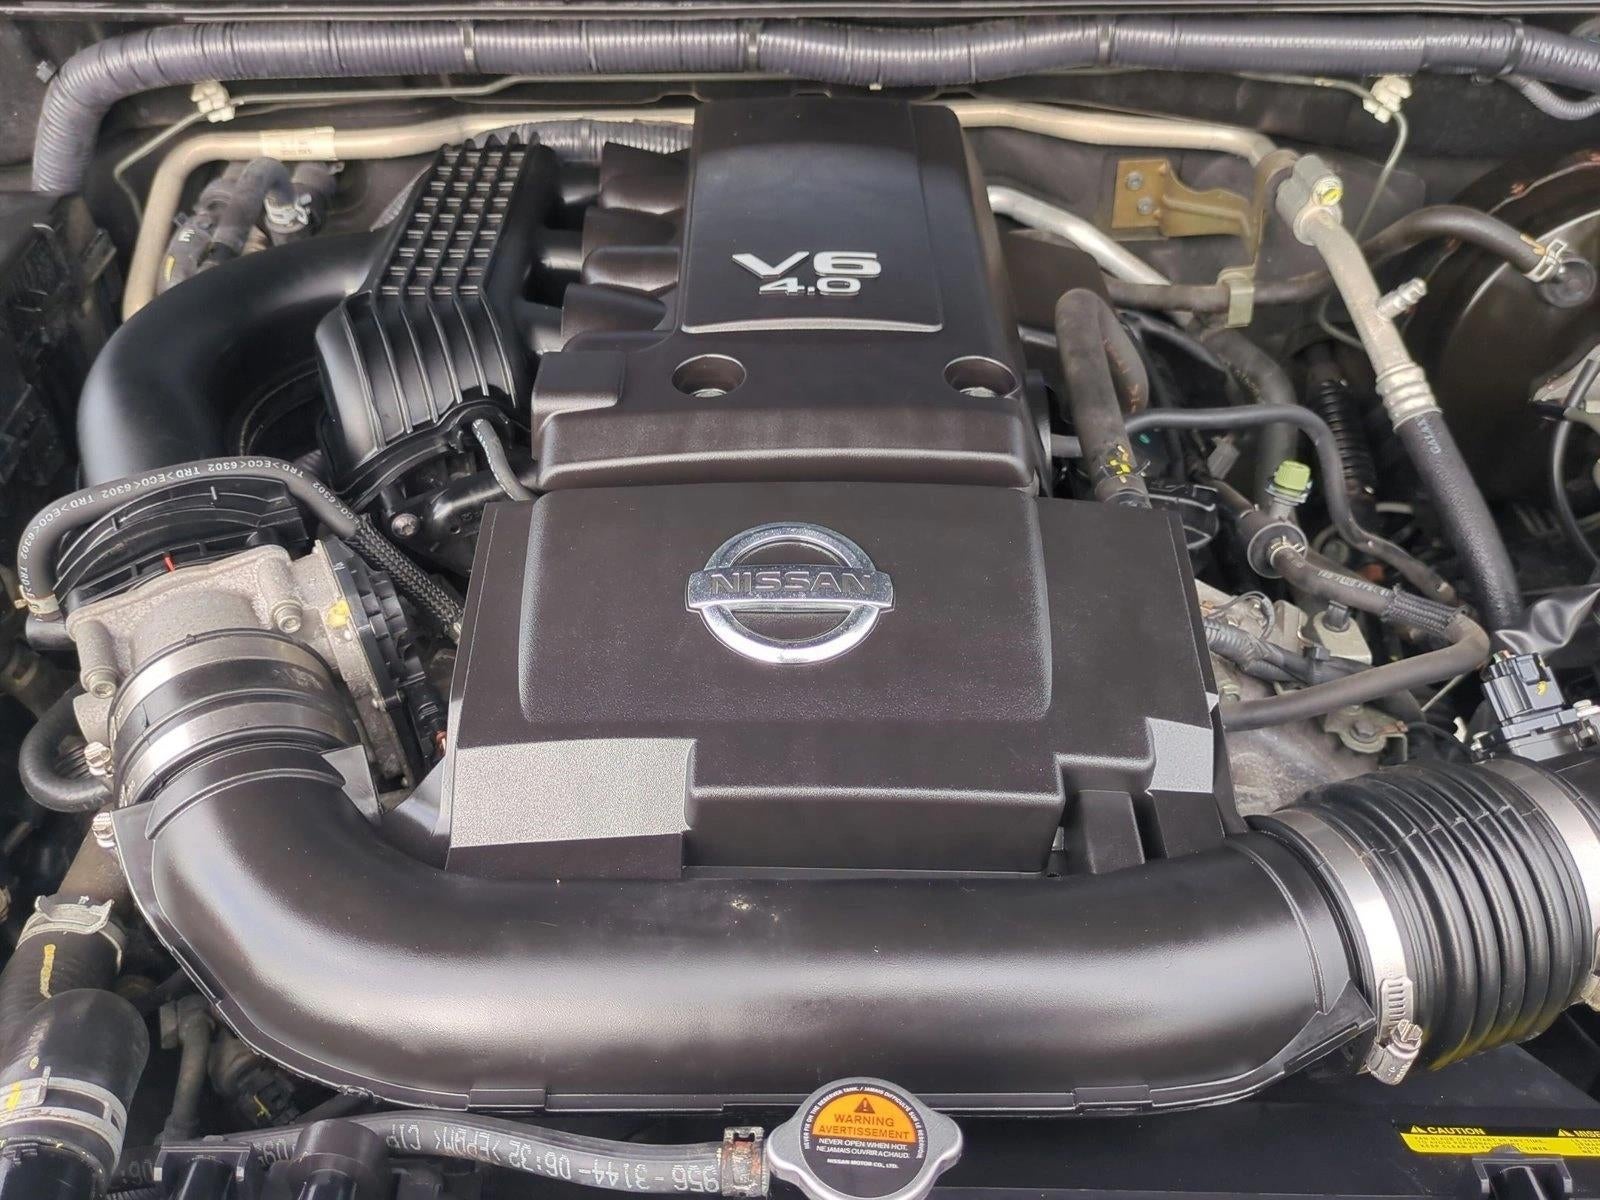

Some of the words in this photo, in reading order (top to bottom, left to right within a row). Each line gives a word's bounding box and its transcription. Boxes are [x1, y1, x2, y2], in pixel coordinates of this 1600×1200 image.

[731, 251, 881, 279] V6
[759, 276, 861, 296] 4.0
[710, 571, 873, 594] NISSAN
[834, 1113, 895, 1127] WARNING
[819, 1125, 910, 1140] AVERTISSEMENT
[1427, 1126, 1486, 1135] CAUTION
[818, 1138, 843, 1146] NEVER
[866, 1141, 890, 1149] WHEN
[891, 1143, 908, 1151] HOT.
